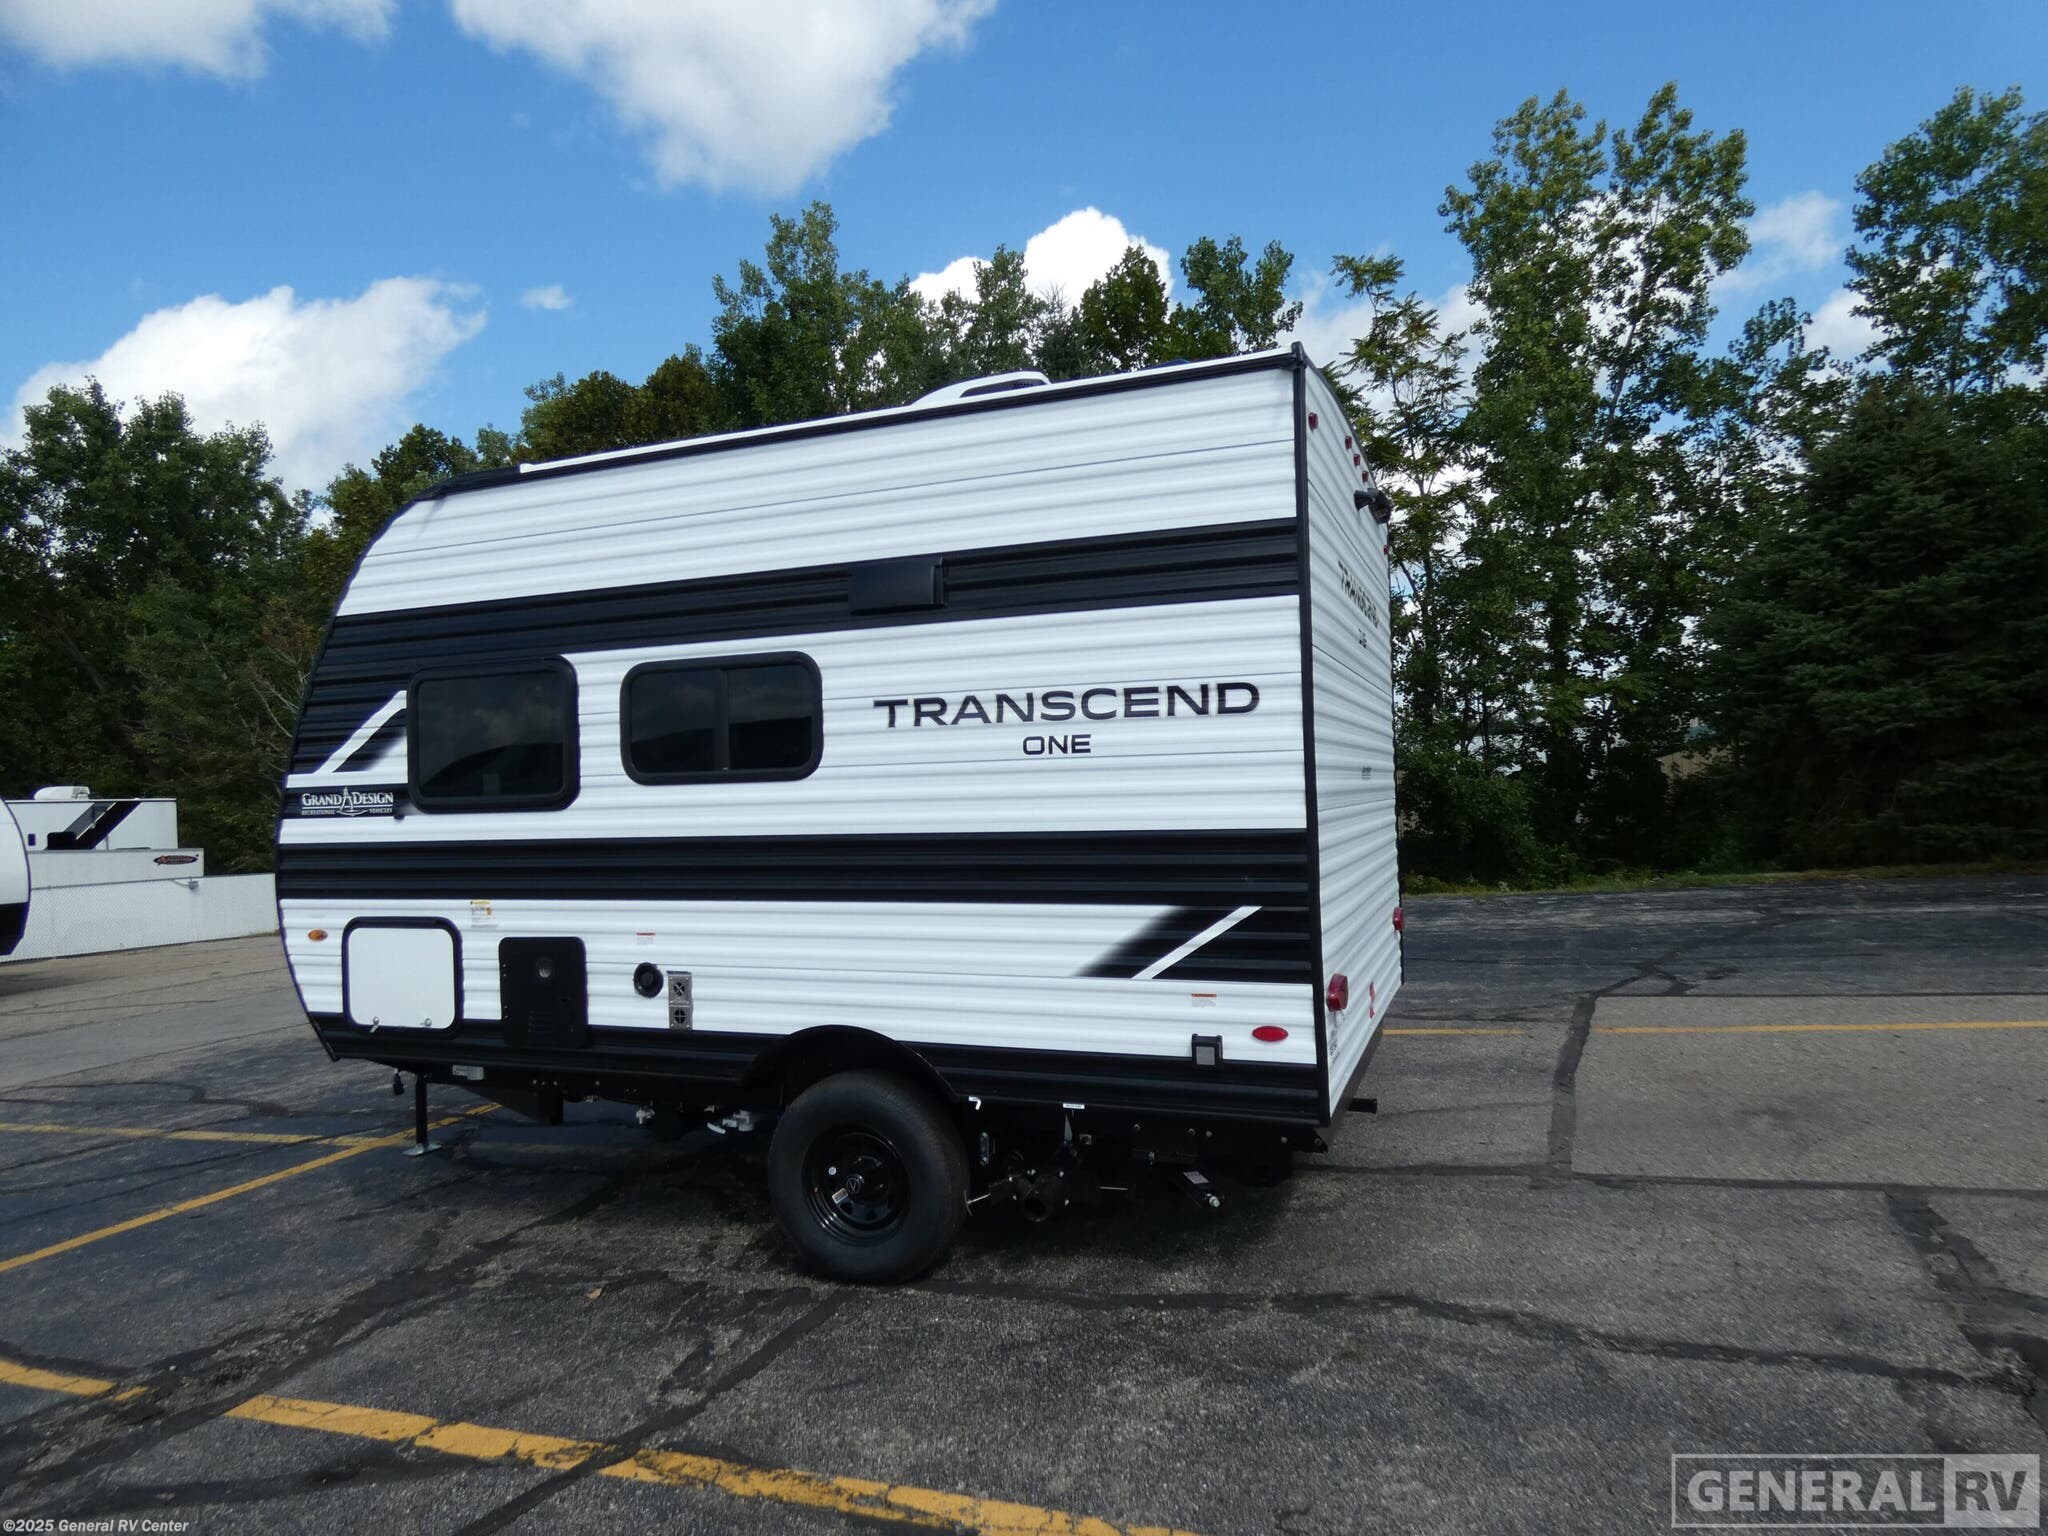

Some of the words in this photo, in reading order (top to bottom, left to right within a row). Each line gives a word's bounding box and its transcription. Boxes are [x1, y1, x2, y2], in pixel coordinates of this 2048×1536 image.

[873, 682, 1259, 728] TRANSCEND
[1023, 734, 1092, 755] ONE
[302, 793, 342, 806] GRAND
[353, 792, 394, 804] DESIGN
